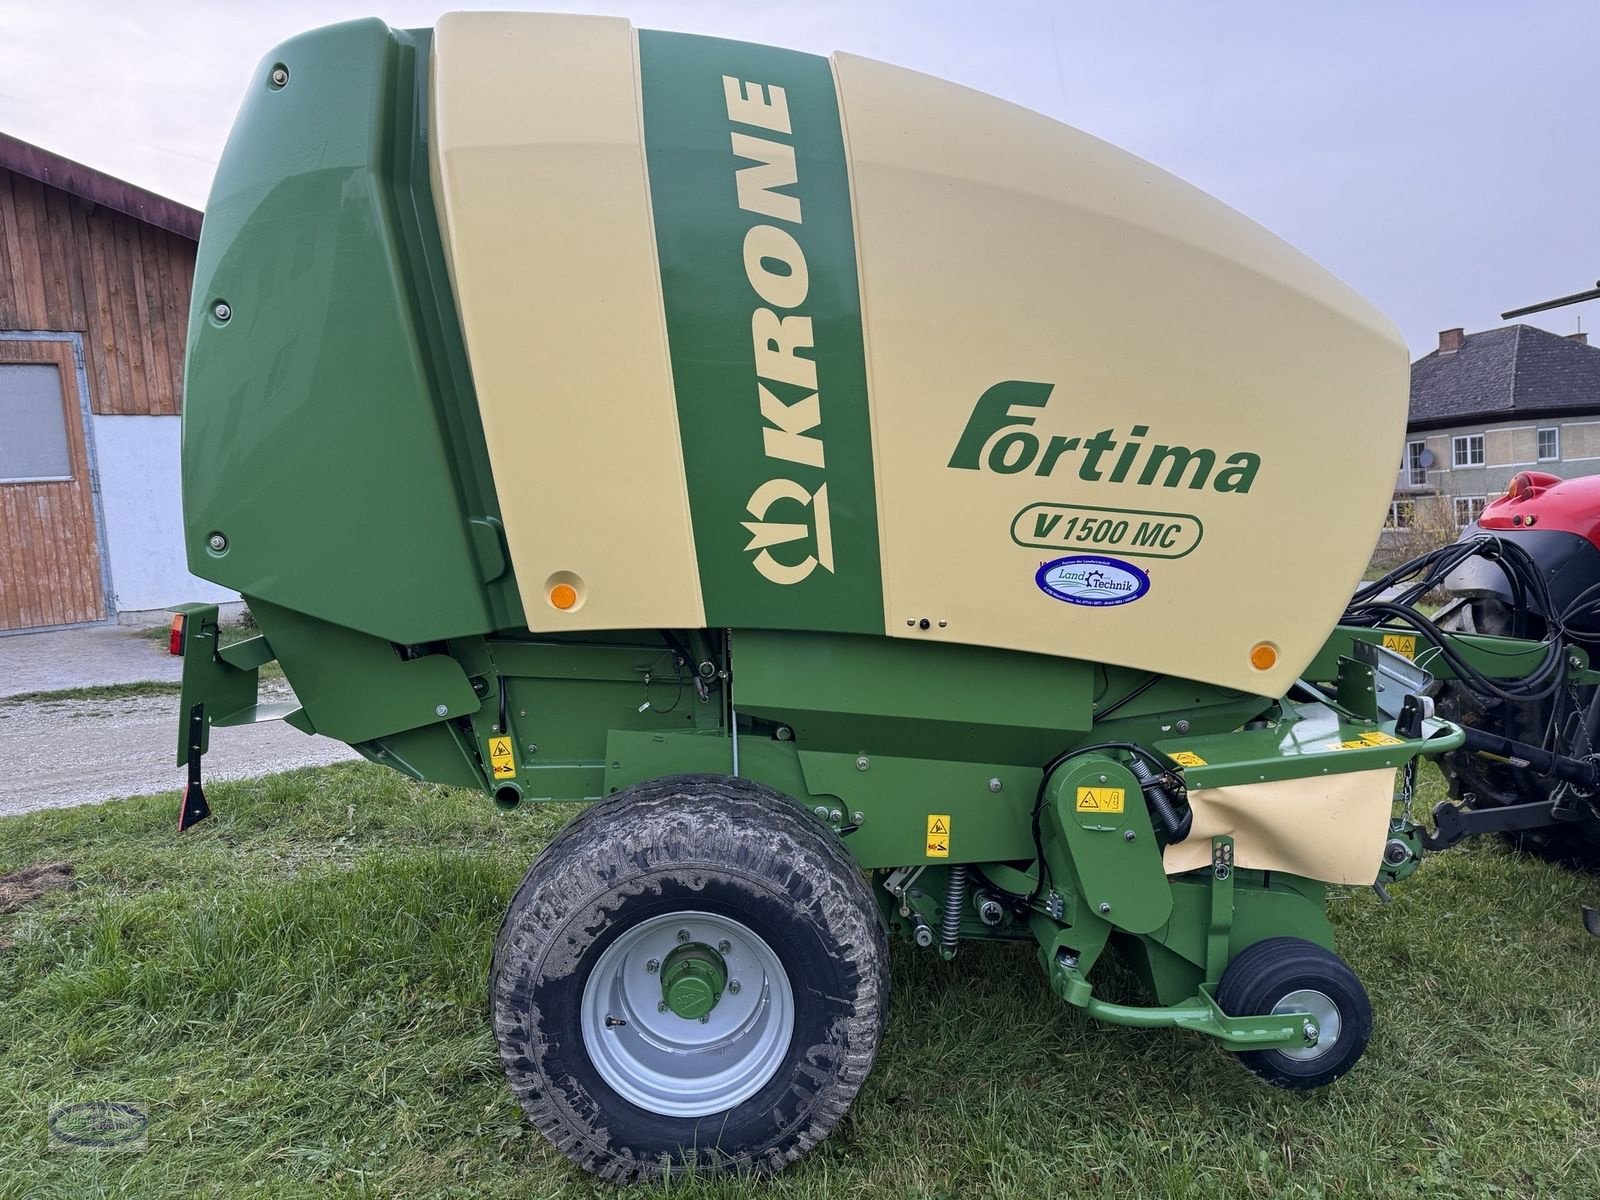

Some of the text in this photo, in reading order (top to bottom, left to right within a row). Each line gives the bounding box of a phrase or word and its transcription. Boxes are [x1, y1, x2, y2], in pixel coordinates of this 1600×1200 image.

[722, 75, 826, 469] KRONE
[947, 380, 1262, 494] Fortima
[1034, 513, 1182, 549] V 1500 MC
[1058, 569, 1086, 581] Land
[1093, 578, 1133, 592] Technik
